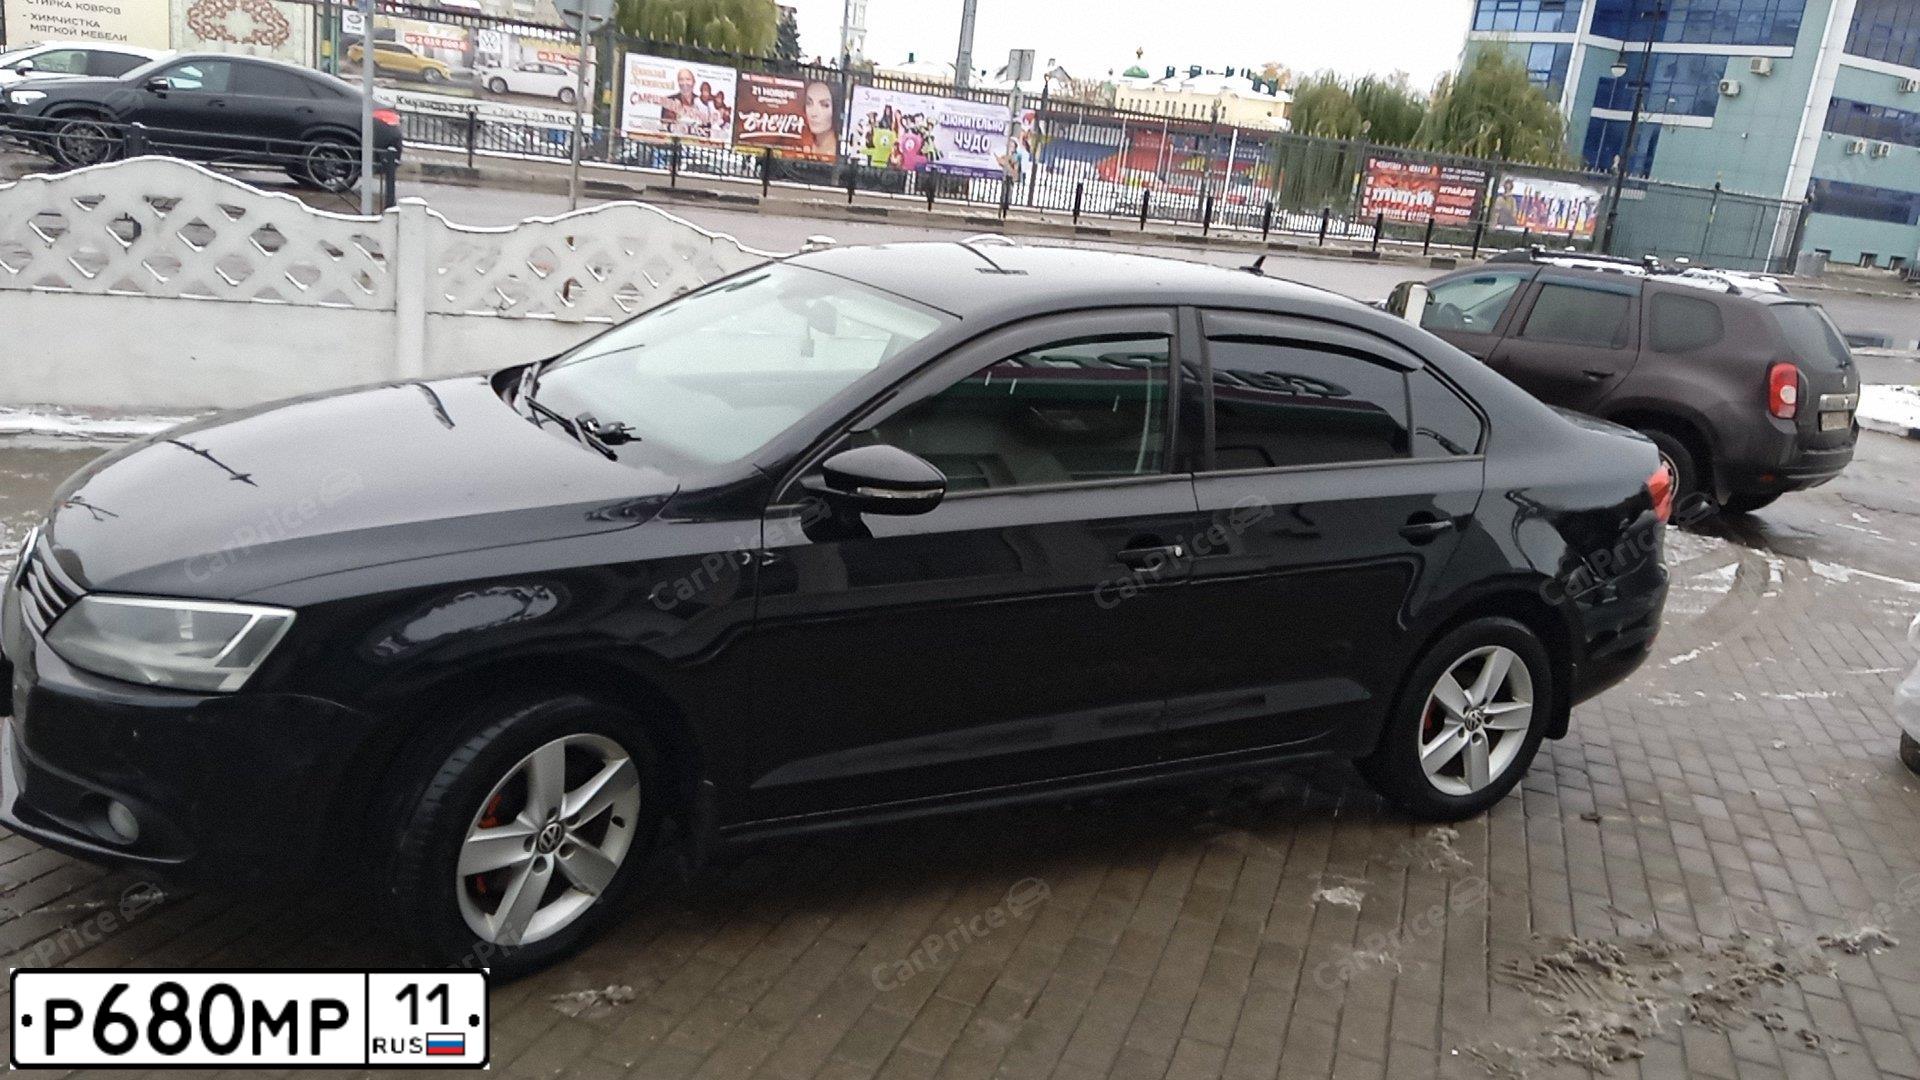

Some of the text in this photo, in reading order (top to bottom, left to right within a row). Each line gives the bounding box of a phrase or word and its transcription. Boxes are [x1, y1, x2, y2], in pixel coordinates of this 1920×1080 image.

[26, 0, 122, 15] СТИРКА КОВРОВ
[30, 12, 101, 28] ХИМЧИСТКА
[29, 23, 128, 42] МЯГКОЙ МЕБЕЛИ
[954, 131, 991, 153] ЧУДО
